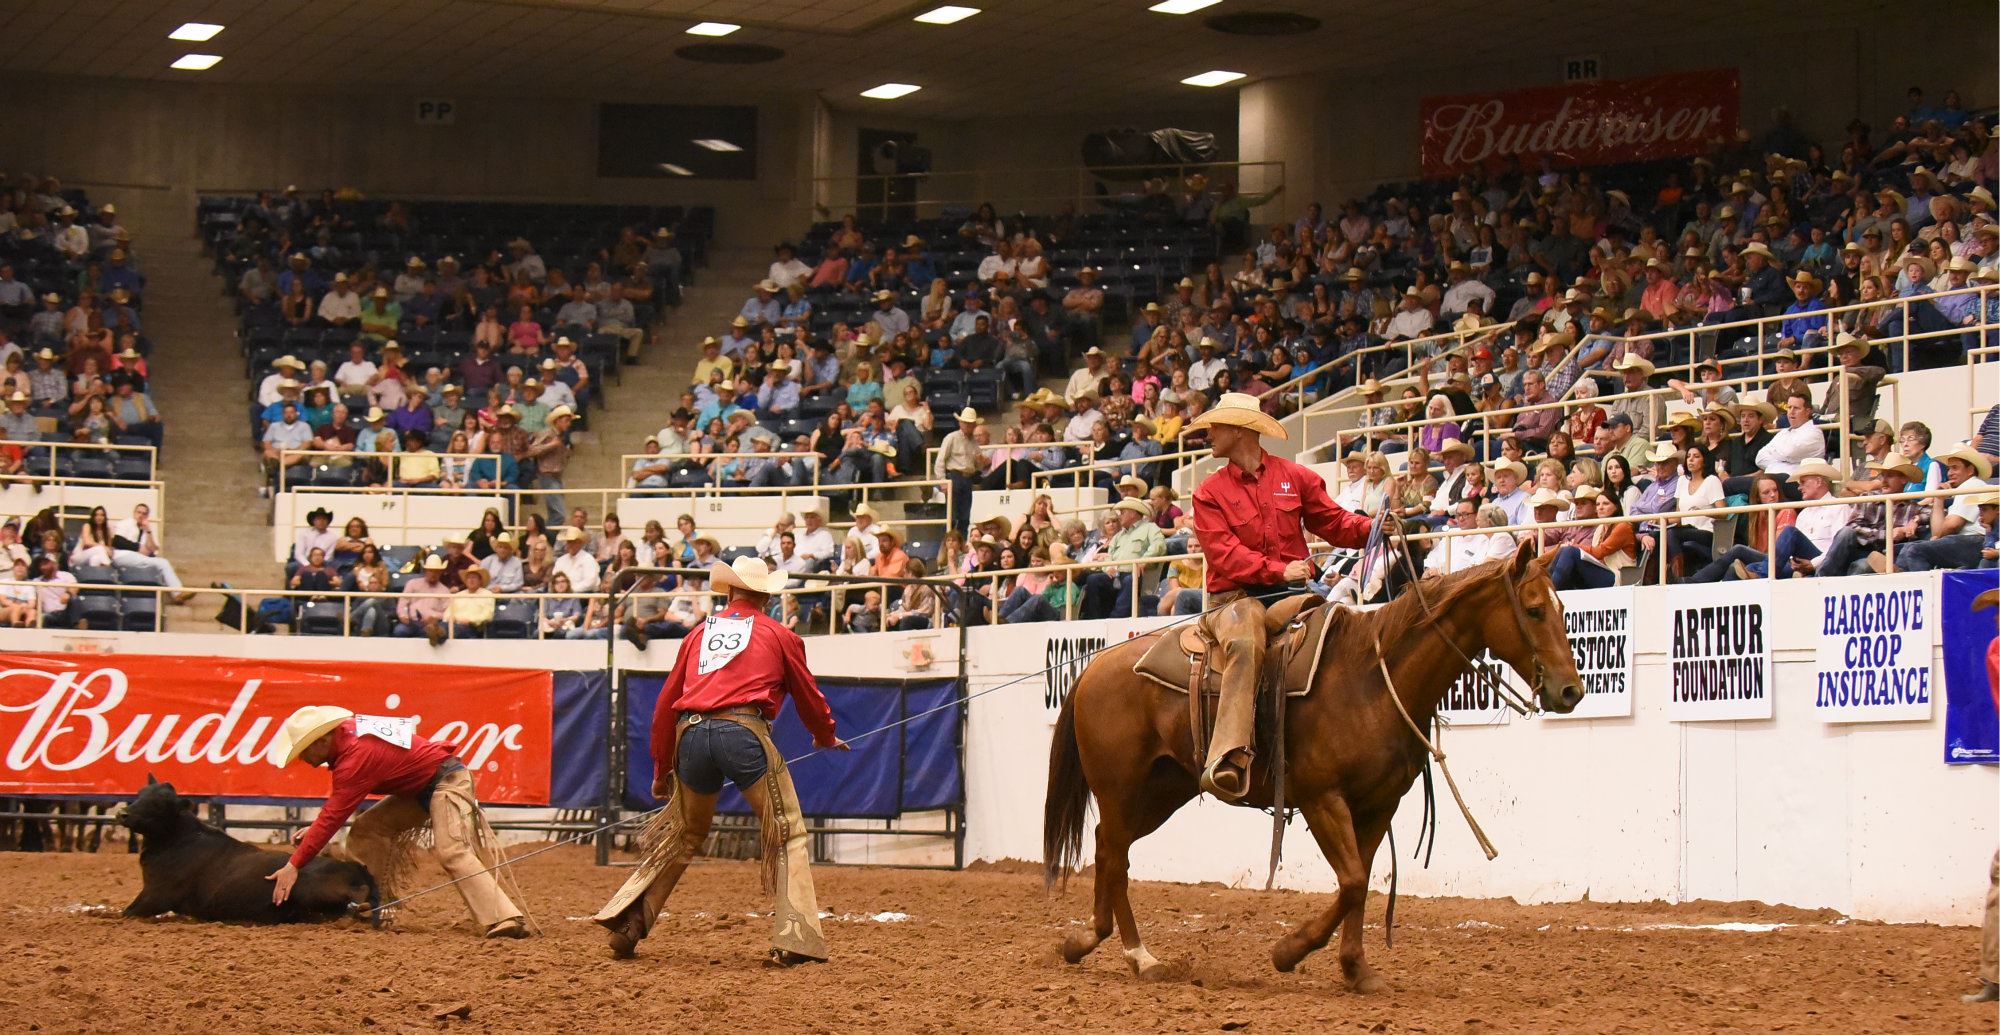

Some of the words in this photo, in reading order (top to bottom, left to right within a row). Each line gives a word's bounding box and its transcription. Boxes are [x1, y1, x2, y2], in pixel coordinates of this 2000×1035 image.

[1567, 60, 1597, 79] RR
[420, 102, 452, 119] PP
[1432, 97, 1722, 166] Budweiser
[1823, 589, 1923, 635] HARGROVE
[708, 632, 742, 651] 63
[1673, 604, 1763, 658] ARTHUR
[1845, 634, 1902, 669] CROP
[1579, 672, 1625, 694] MENTS
[1673, 657, 1763, 702] FOUNDATION
[1816, 667, 1929, 707] INSURANCE
